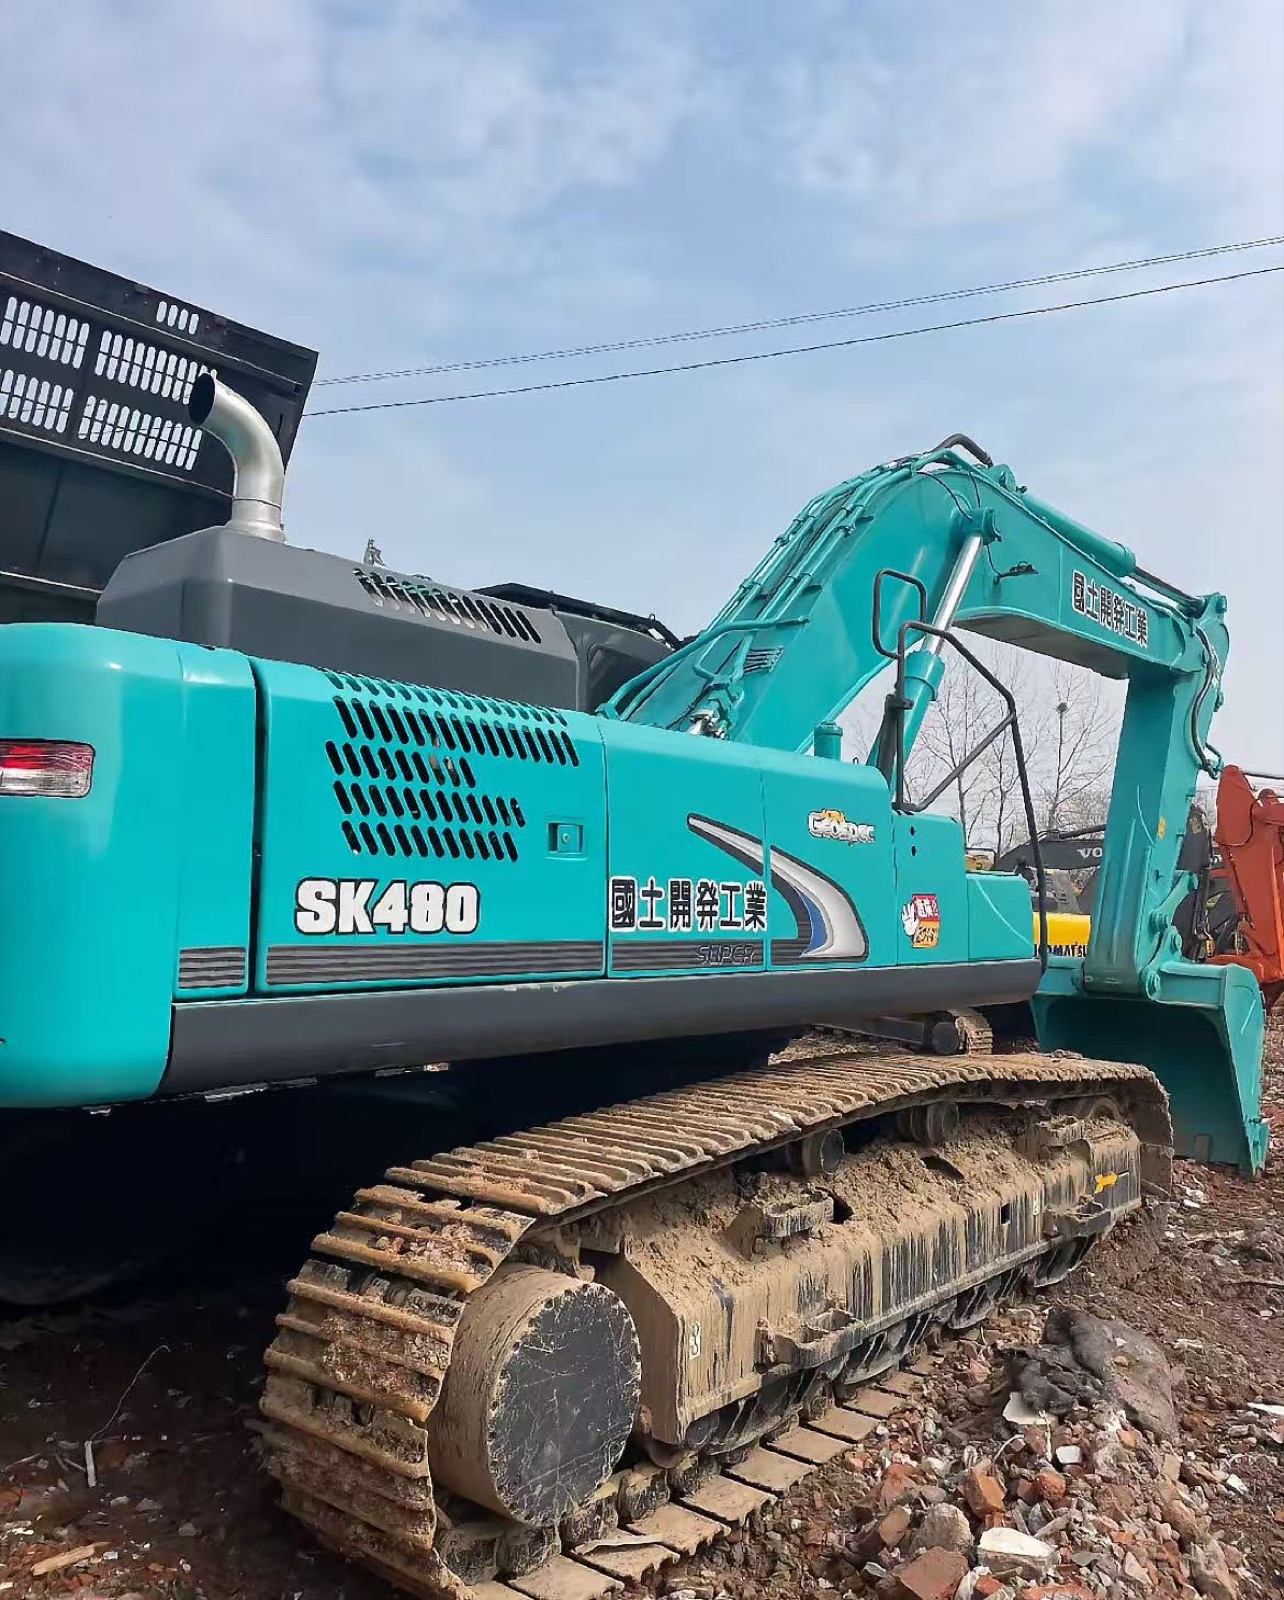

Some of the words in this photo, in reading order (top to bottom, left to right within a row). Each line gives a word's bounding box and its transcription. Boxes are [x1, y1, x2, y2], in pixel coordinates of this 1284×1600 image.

[294, 877, 480, 936] SK480
[609, 876, 767, 931] 國土開発工業
